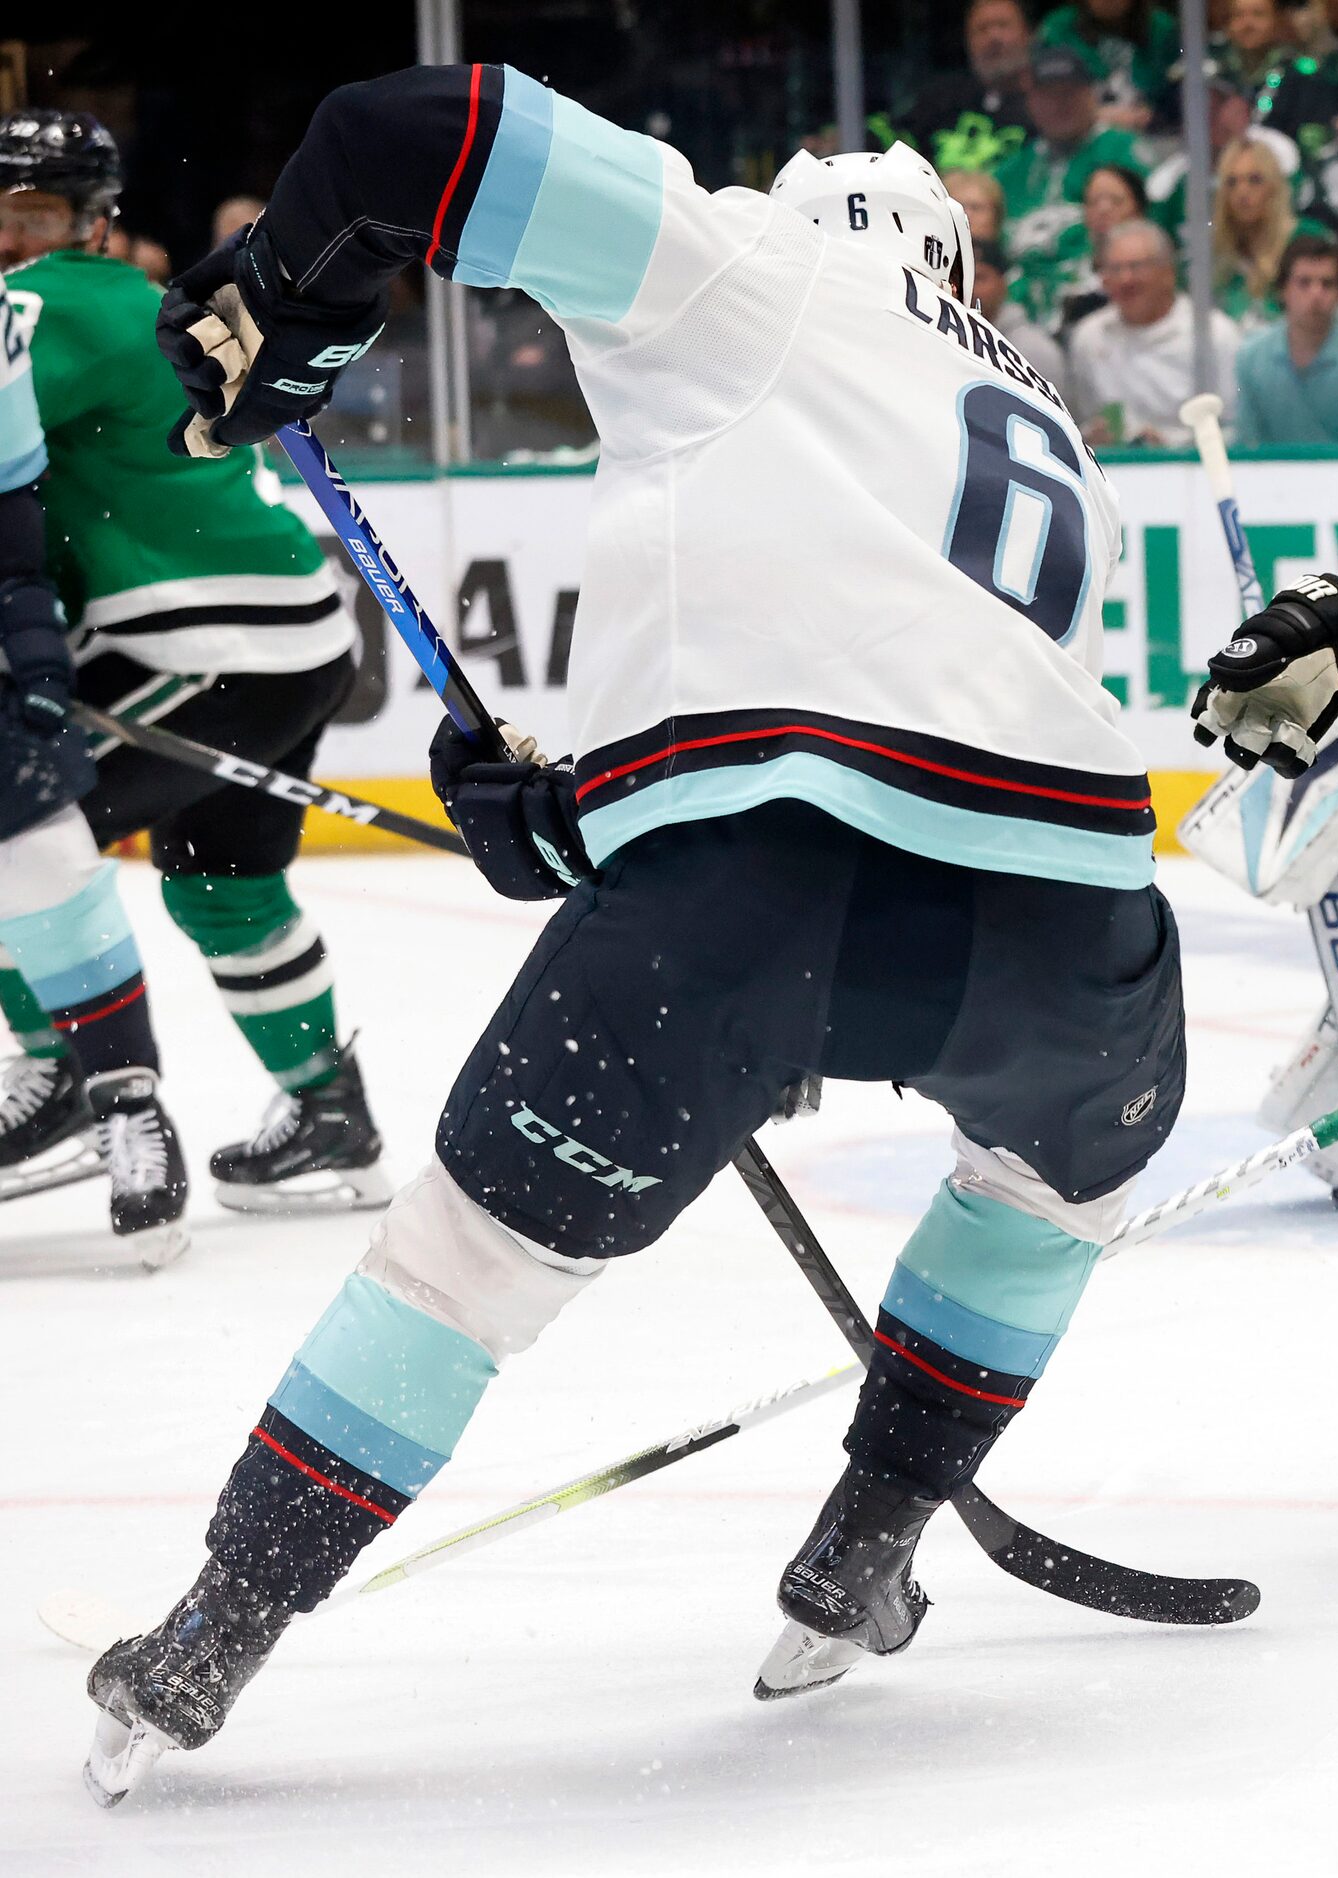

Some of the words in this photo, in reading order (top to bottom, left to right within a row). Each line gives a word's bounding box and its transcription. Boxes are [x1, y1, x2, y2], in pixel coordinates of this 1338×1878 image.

[847, 193, 868, 231] 6
[901, 266, 1070, 418] LARSS
[940, 380, 1094, 650] 6
[213, 755, 381, 826] CCM
[510, 1103, 664, 1193] CCM
